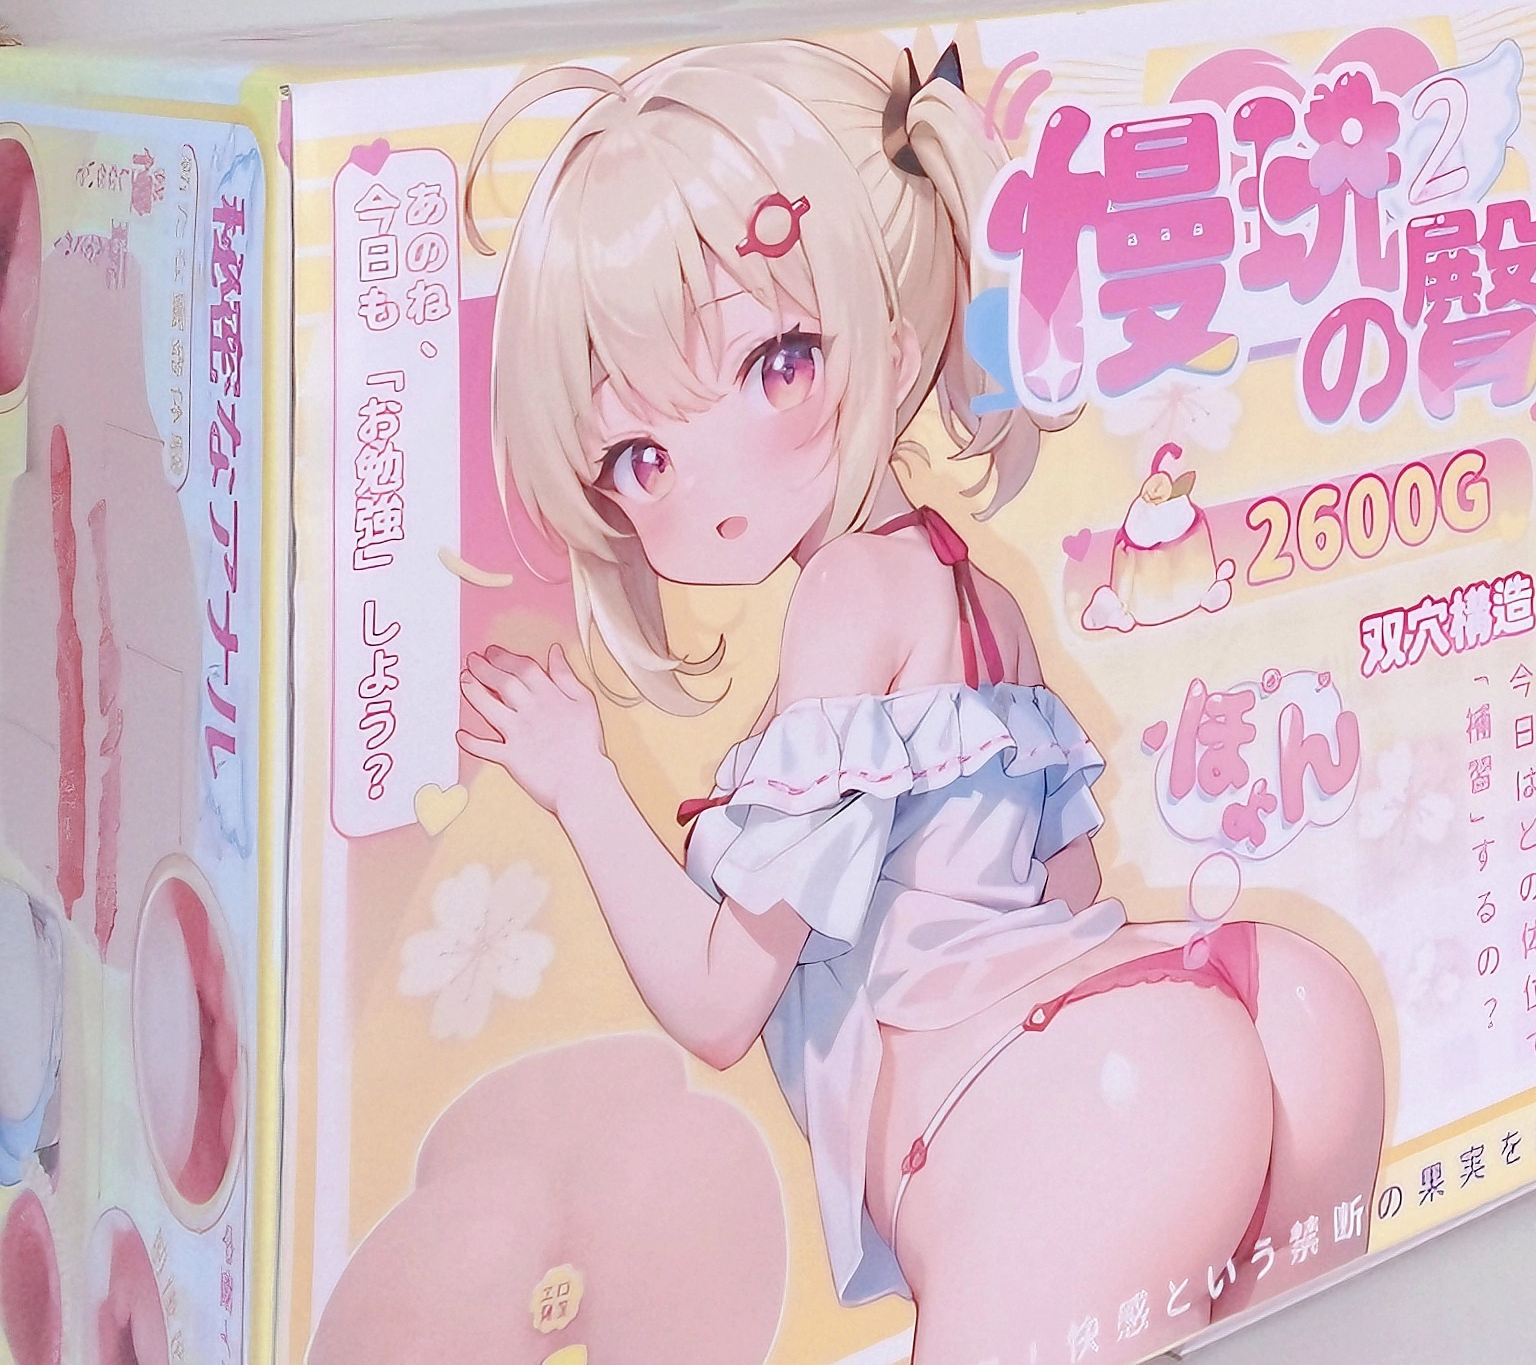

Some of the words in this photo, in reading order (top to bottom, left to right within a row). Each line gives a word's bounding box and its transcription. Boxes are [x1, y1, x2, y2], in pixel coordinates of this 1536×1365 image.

[406, 182, 450, 359] あのね、
[1245, 449, 1491, 587] 2600G
